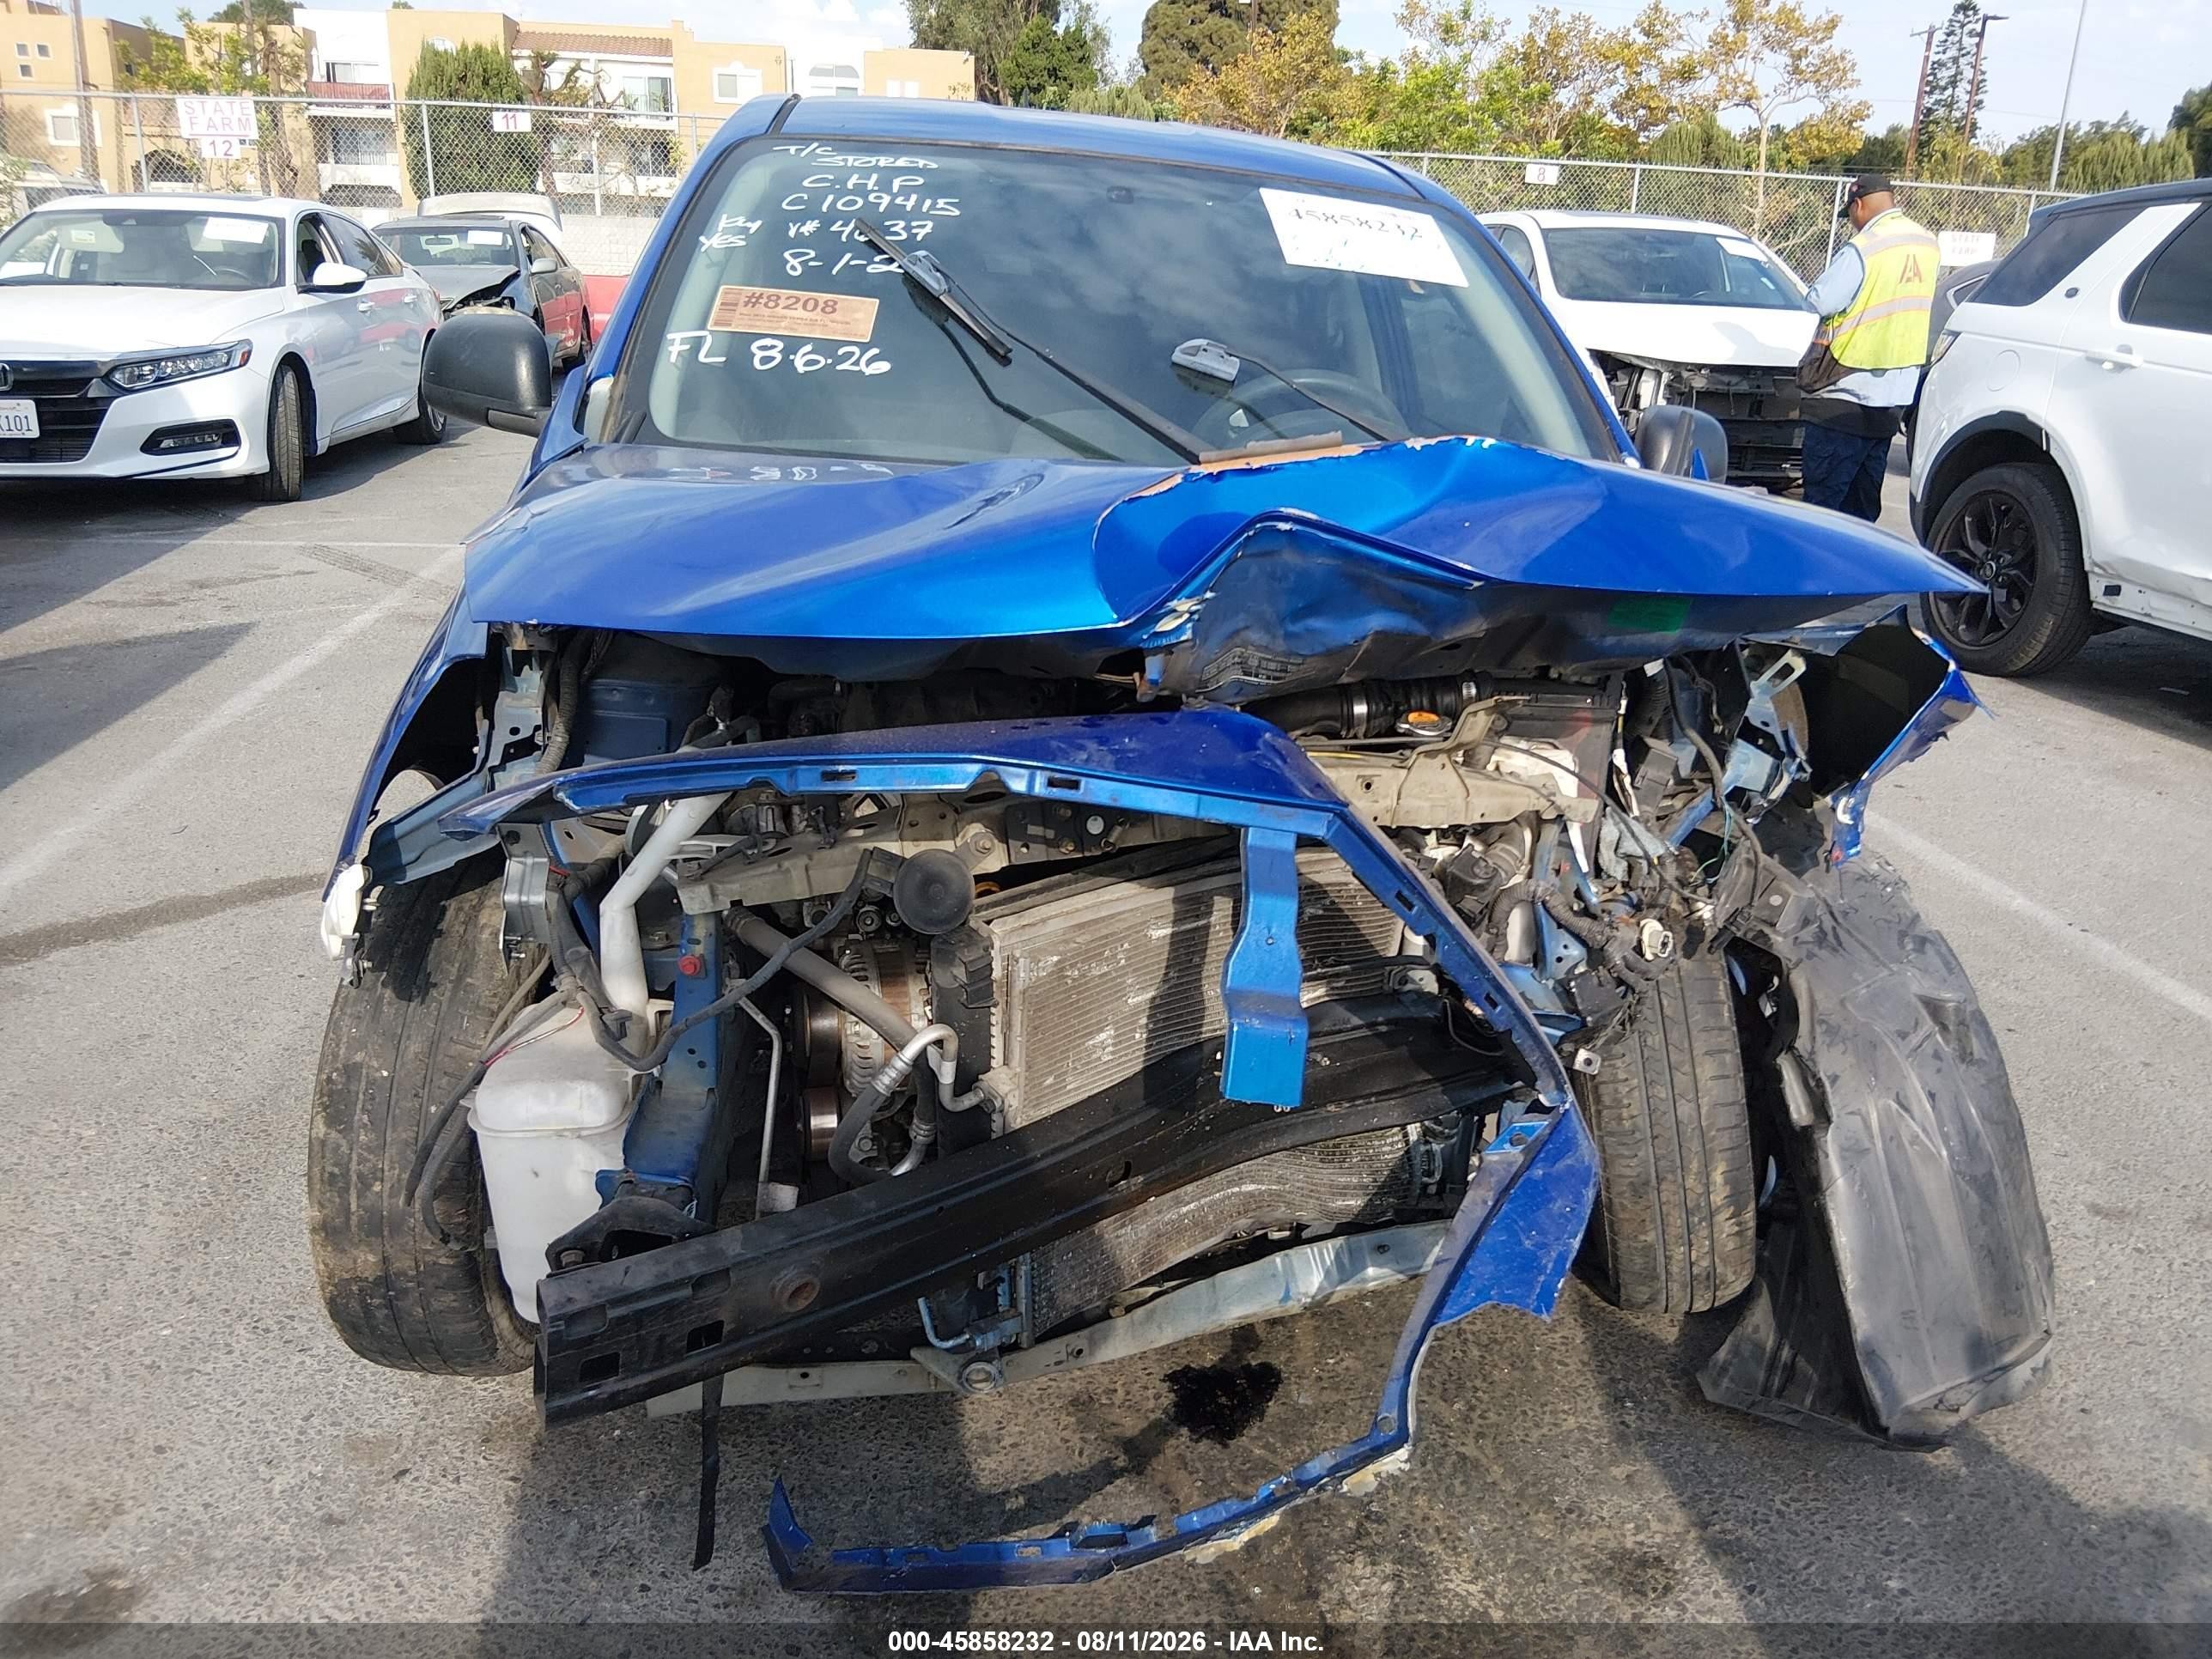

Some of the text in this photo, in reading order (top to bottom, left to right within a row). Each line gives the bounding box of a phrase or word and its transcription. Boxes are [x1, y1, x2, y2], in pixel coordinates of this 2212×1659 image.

[184, 100, 252, 116] STATE
[189, 116, 252, 131] FARM
[501, 112, 517, 130] 11
[209, 139, 234, 156] 12
[811, 155, 939, 169] STORED
[1538, 167, 1546, 181] 8
[742, 292, 839, 315] #8208
[666, 331, 727, 363] FL
